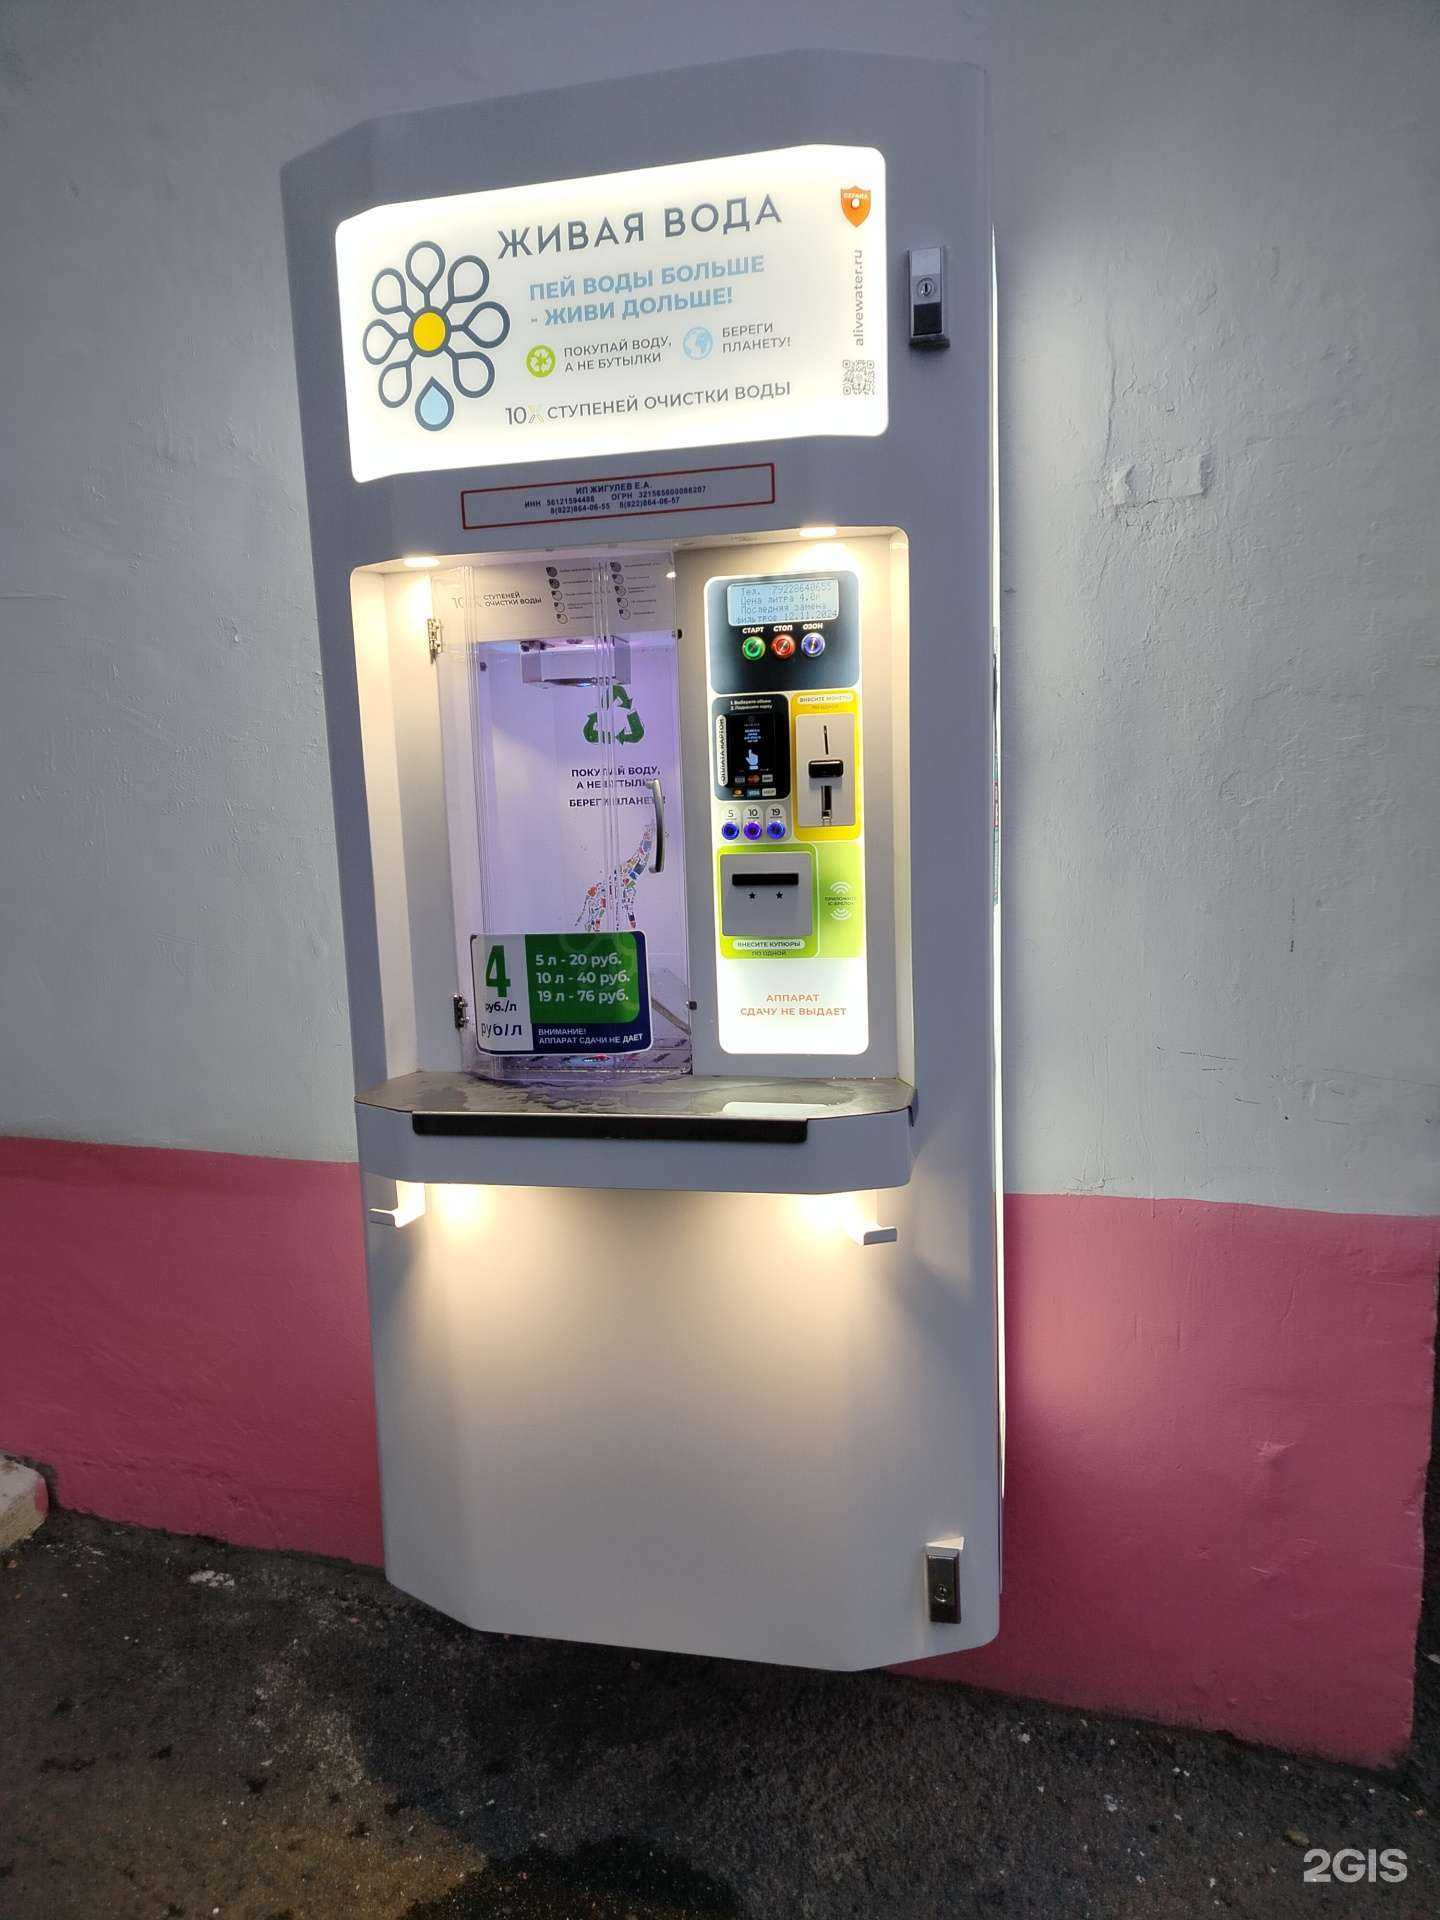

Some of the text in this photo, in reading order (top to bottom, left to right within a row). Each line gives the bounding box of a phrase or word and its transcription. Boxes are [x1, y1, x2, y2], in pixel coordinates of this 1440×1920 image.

[497, 193, 782, 260] ЖИВАЯ ВОДА
[529, 255, 765, 301] ПЕЙ ВОДЫ БОЛЬШЕ
[544, 302, 615, 326] ЖИВИ
[621, 286, 733, 320] ДОЛЬШЕ!
[852, 249, 864, 347] alivewater.ru
[722, 322, 791, 354] БЕРЕГИ ПЛАНЕТУ!
[564, 335, 672, 358] ПОКУПАЙ ВОДУ,
[565, 352, 662, 373] А НЕ БУТЫЛКИ
[505, 381, 791, 425] 10 СТУПЕНЕЙ ОЧИСТКИ ВОДЫ
[576, 486, 588, 494] ИП
[485, 598, 519, 607] ОЧИСТКИ
[742, 622, 824, 634] СТАРТ СТОП ОЗОН
[628, 766, 661, 776] ВОДУ,
[577, 781, 584, 789] А
[587, 780, 601, 789] НЕ
[728, 808, 781, 817] 5 10 19
[770, 940, 801, 948] КУПЮРЫ
[535, 954, 545, 966] 5
[548, 956, 557, 965] л
[570, 954, 587, 965] 20
[591, 952, 622, 968] руб.
[485, 944, 511, 998] 4
[536, 972, 551, 984] 10
[555, 974, 564, 983] л
[577, 972, 596, 983] 40
[600, 970, 631, 986] руб.
[537, 990, 551, 1002] 19
[555, 992, 565, 1001] л
[577, 990, 595, 1001] 76
[598, 988, 630, 1004] руб.
[766, 993, 820, 1003] АППАРАТ
[740, 1007, 847, 1017] СДАЧУ НЕ ВЫДАЕТ
[538, 1027, 587, 1036] ВНИМАНИЕ!
[539, 1033, 644, 1046] АППАРАТ СДАЧИ НЕ ДАЕТ
